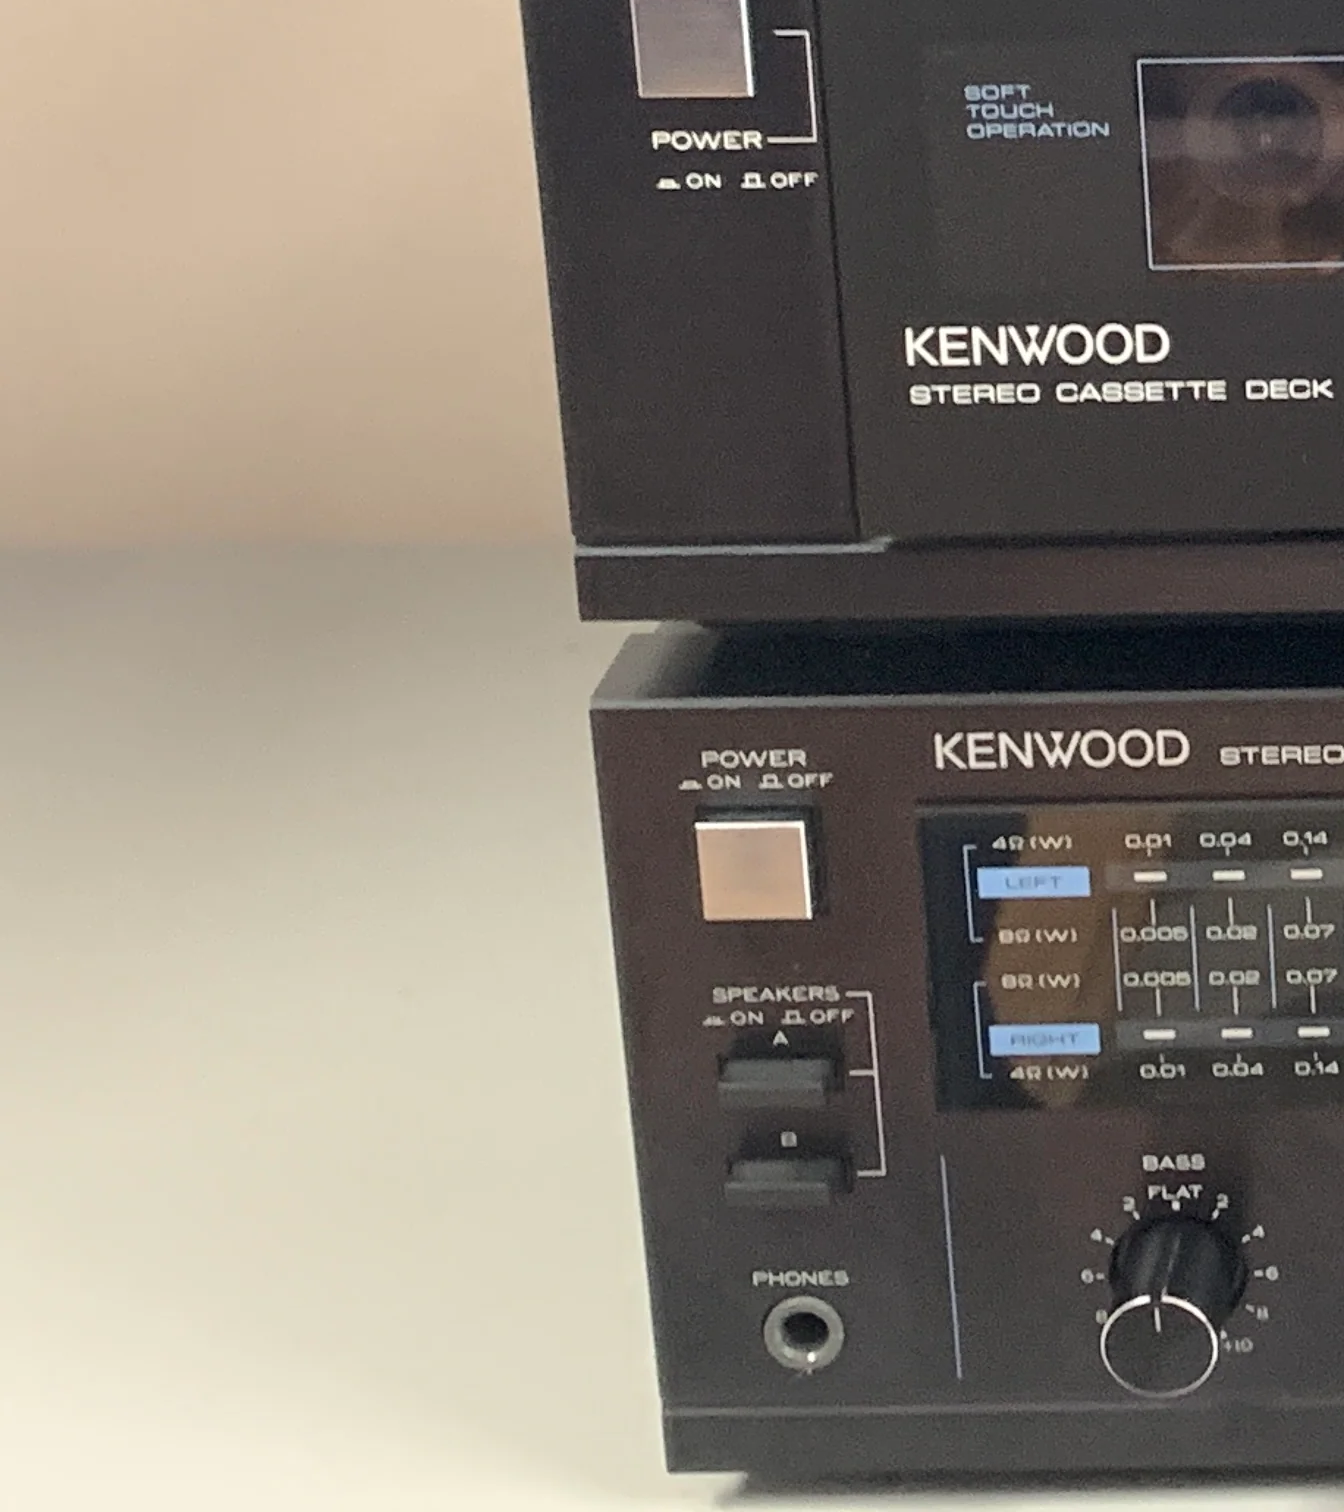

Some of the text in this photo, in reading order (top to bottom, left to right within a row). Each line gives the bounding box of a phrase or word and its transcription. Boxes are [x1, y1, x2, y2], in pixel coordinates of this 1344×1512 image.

[964, 84, 1030, 101] SOFT
[966, 103, 1053, 119] TOUCH
[967, 121, 1109, 139] OPERATION
[652, 131, 762, 150] POWER
[686, 172, 818, 189] ON OFF
[905, 323, 1170, 366] KENWOOD
[910, 383, 1040, 405] STEREO
[1056, 380, 1226, 402] CASSETTE
[1246, 379, 1333, 399] DECK
[935, 729, 1190, 769] KENWOOD
[702, 749, 806, 768] POWER
[707, 773, 833, 789] ON OFF
[713, 986, 840, 1003] SPEAKERS
[1143, 1154, 1205, 1171] BASS
[1148, 1185, 1202, 1201] FLAT
[753, 1270, 849, 1286] PHONES
